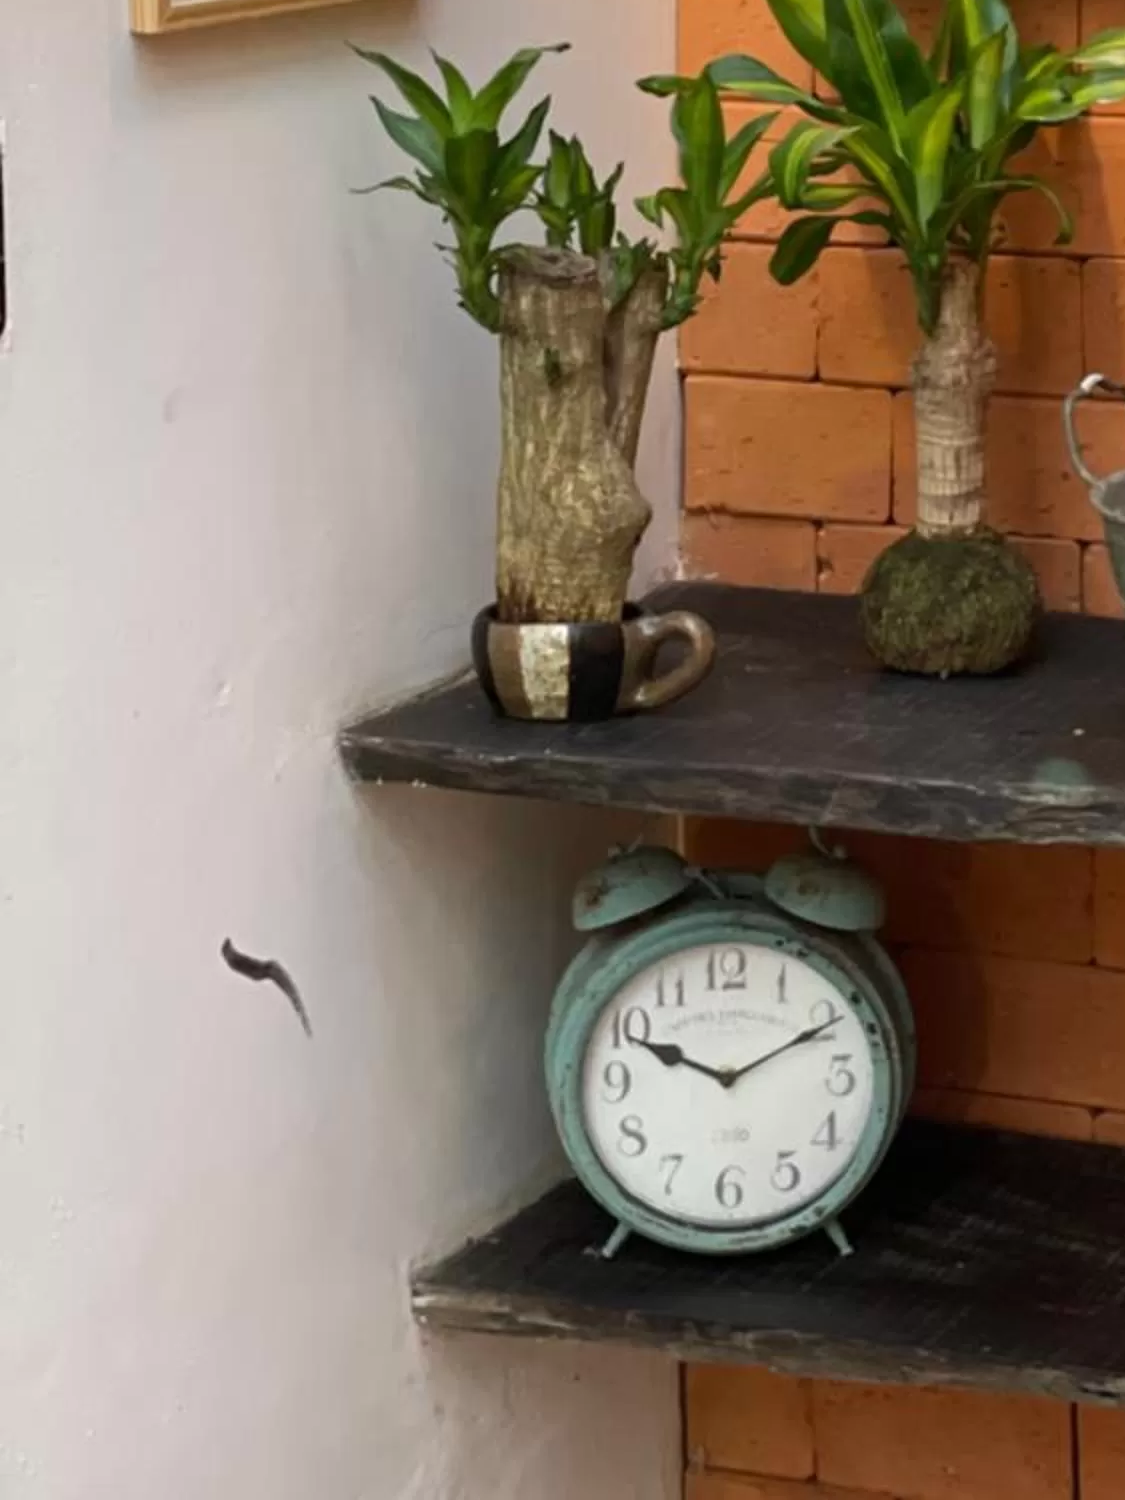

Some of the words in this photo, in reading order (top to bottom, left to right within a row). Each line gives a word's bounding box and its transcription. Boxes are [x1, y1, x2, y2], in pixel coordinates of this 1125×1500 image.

[654, 967, 685, 1008] 11
[706, 948, 747, 992] 12
[776, 963, 788, 1003] 1
[612, 1006, 651, 1048] 10
[809, 999, 837, 1041] 2
[603, 1060, 631, 1104] 9
[824, 1053, 857, 1097] 3
[617, 1114, 647, 1157] 8
[810, 1110, 842, 1150] 4
[658, 1153, 684, 1196] 7
[714, 1164, 747, 1209] 6
[770, 1150, 801, 1192] 5
